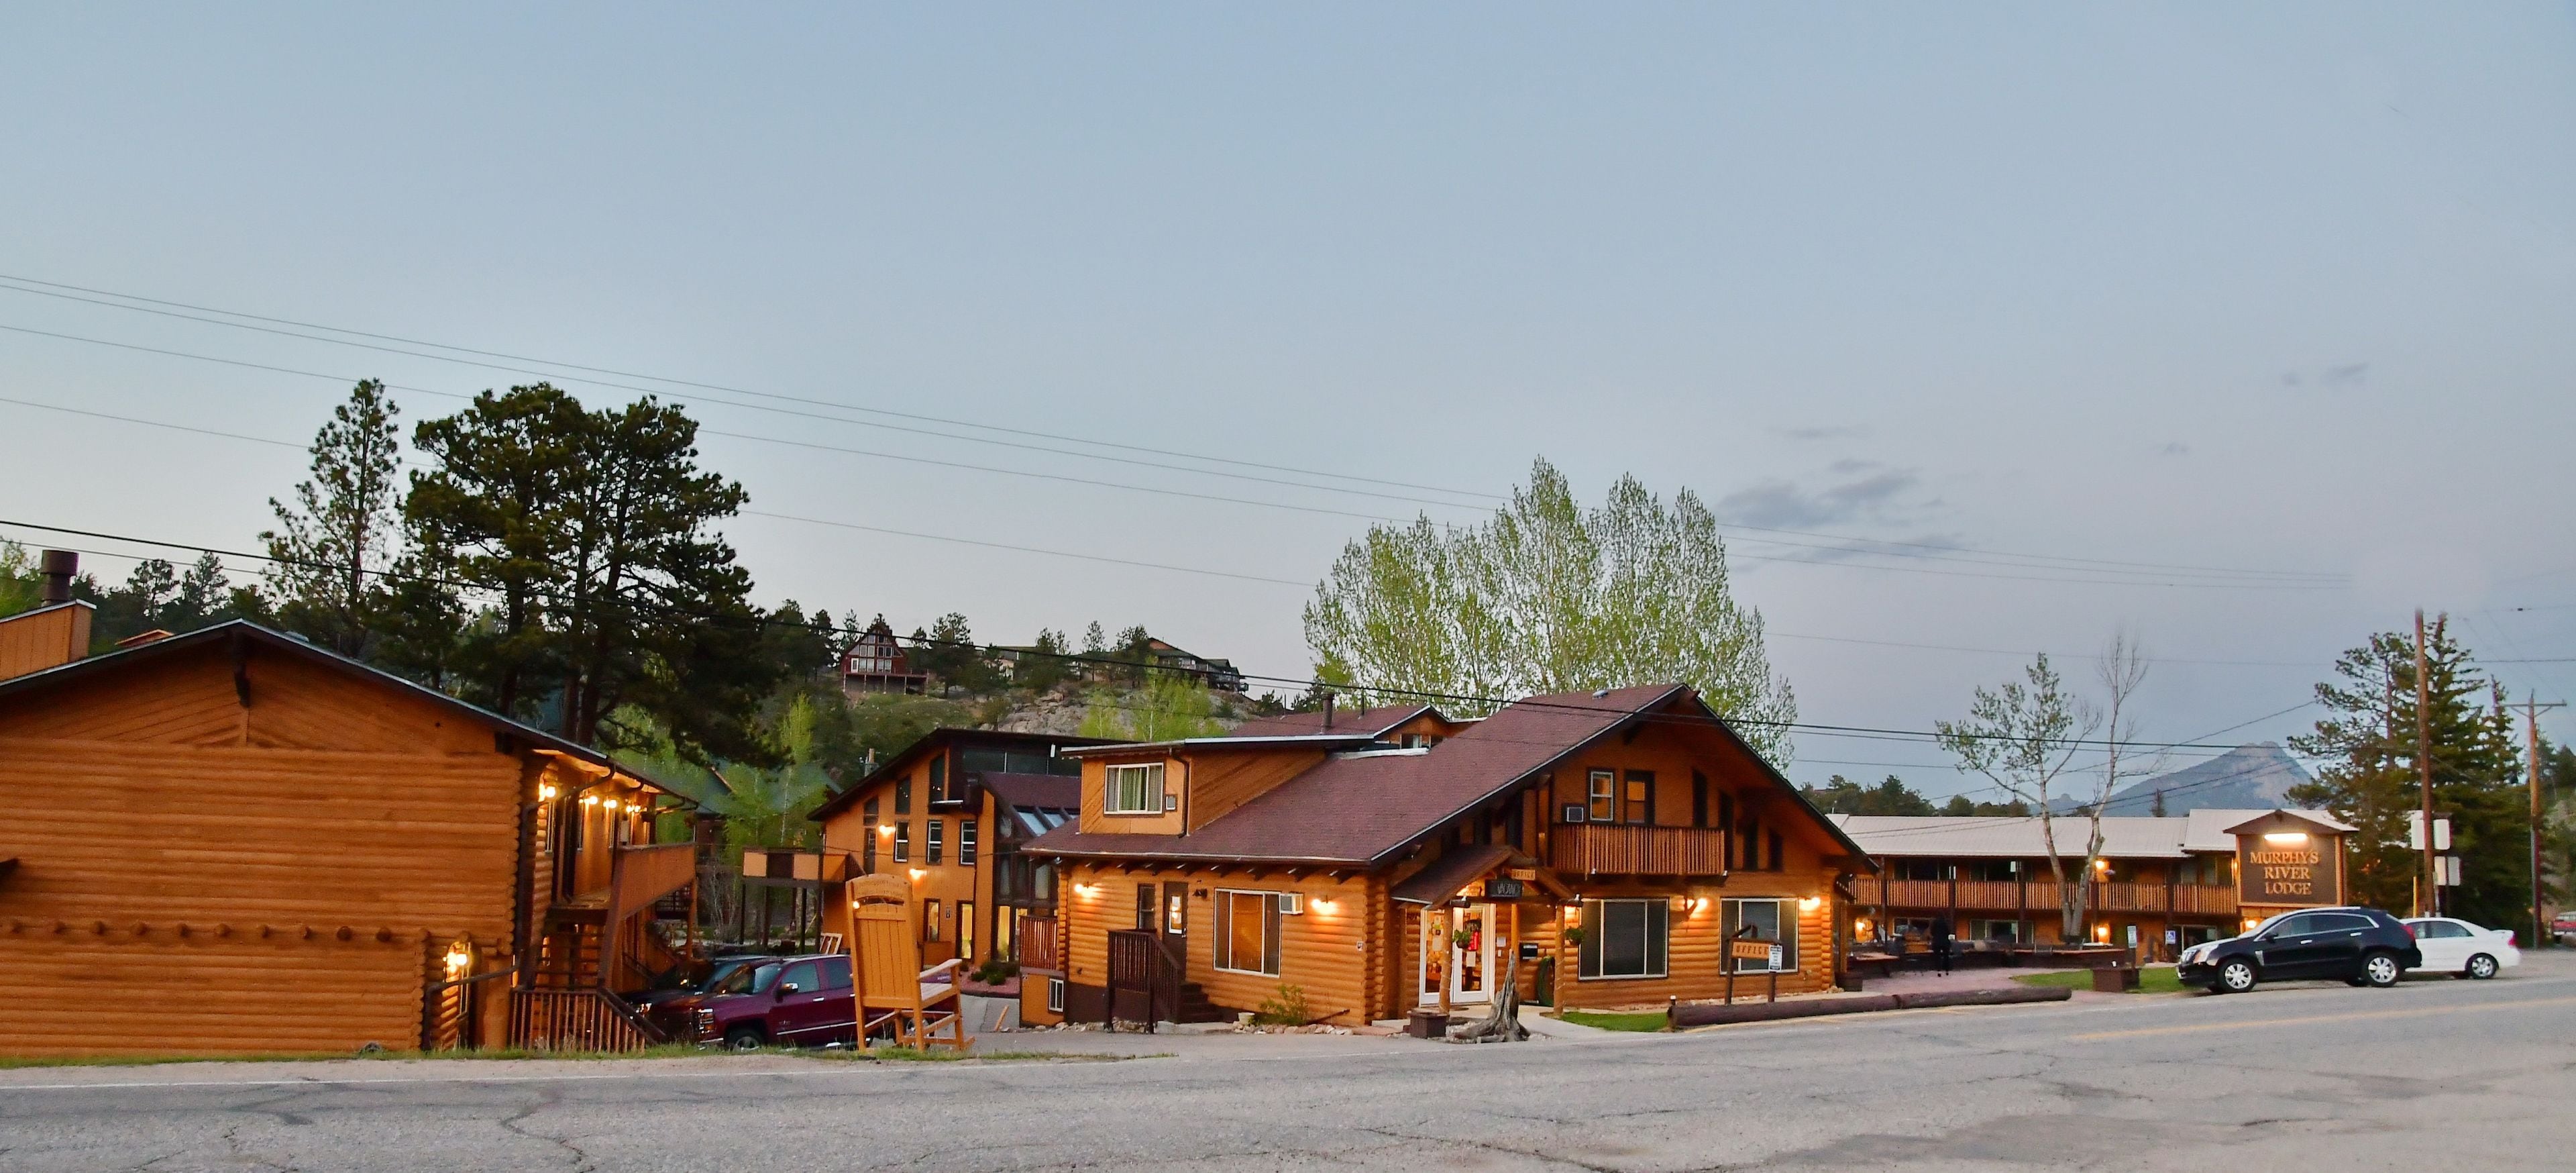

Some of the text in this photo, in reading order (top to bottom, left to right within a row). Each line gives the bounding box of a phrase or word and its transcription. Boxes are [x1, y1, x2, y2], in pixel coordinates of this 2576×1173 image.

[2249, 848, 2320, 864] MURPHY'S
[2263, 866, 2311, 880] RIVER
[2265, 882, 2312, 895] LODGE
[1735, 945, 1768, 956] OFFICE
